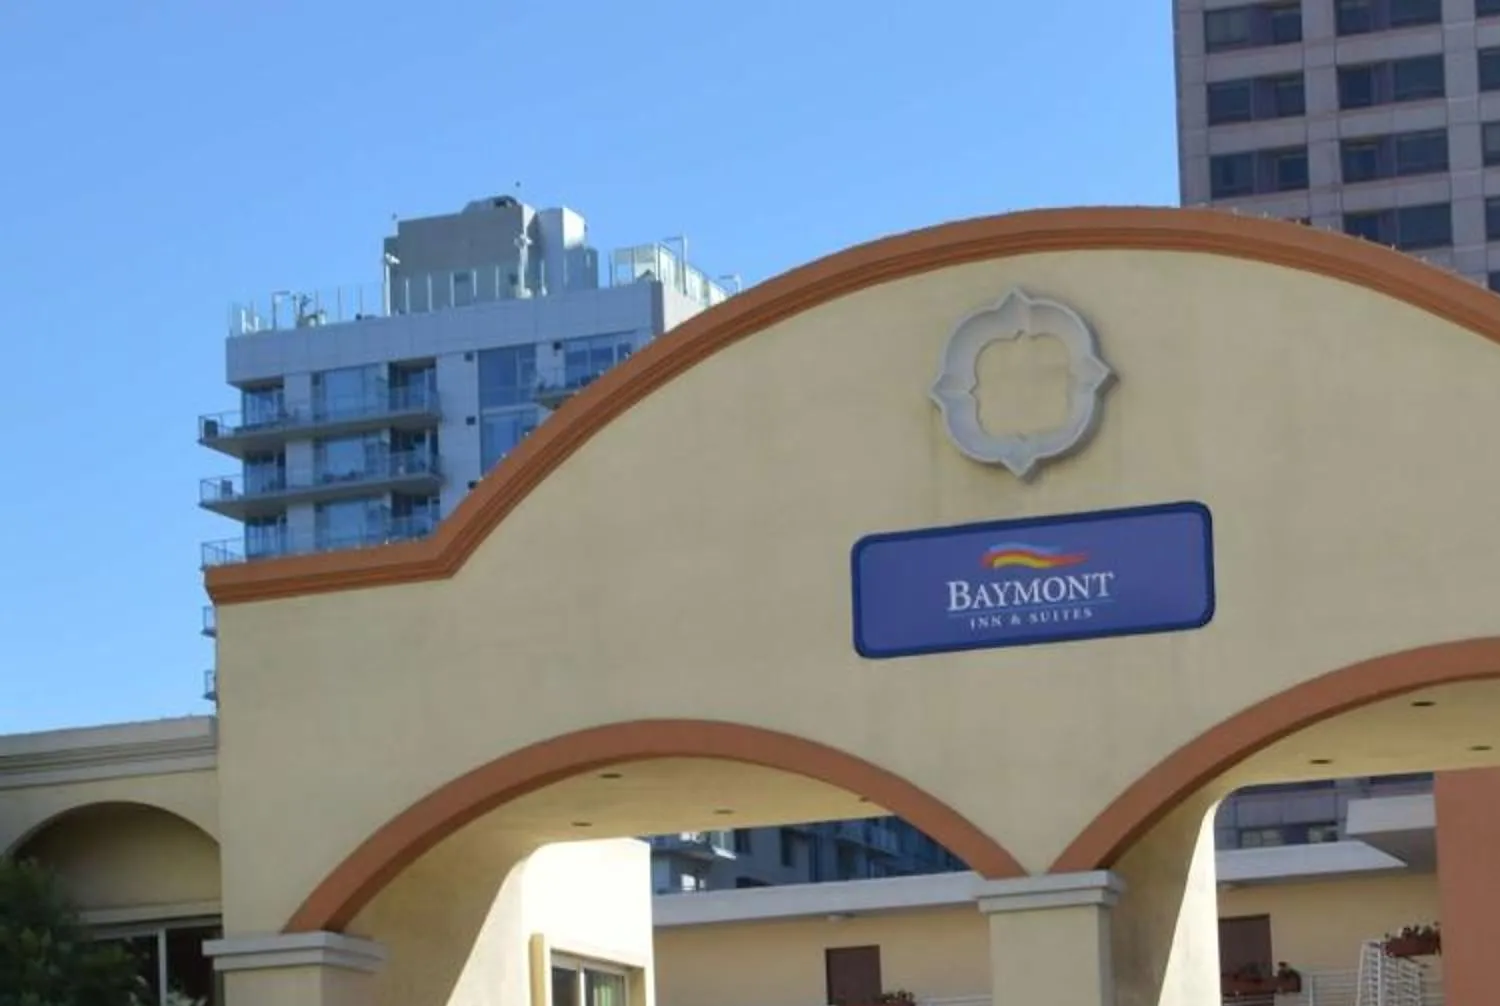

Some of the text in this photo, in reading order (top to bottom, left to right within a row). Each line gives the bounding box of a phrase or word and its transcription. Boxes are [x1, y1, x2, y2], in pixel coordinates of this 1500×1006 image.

[946, 571, 1115, 611] BAYMONT
[970, 607, 1093, 629] INN & SUITES
